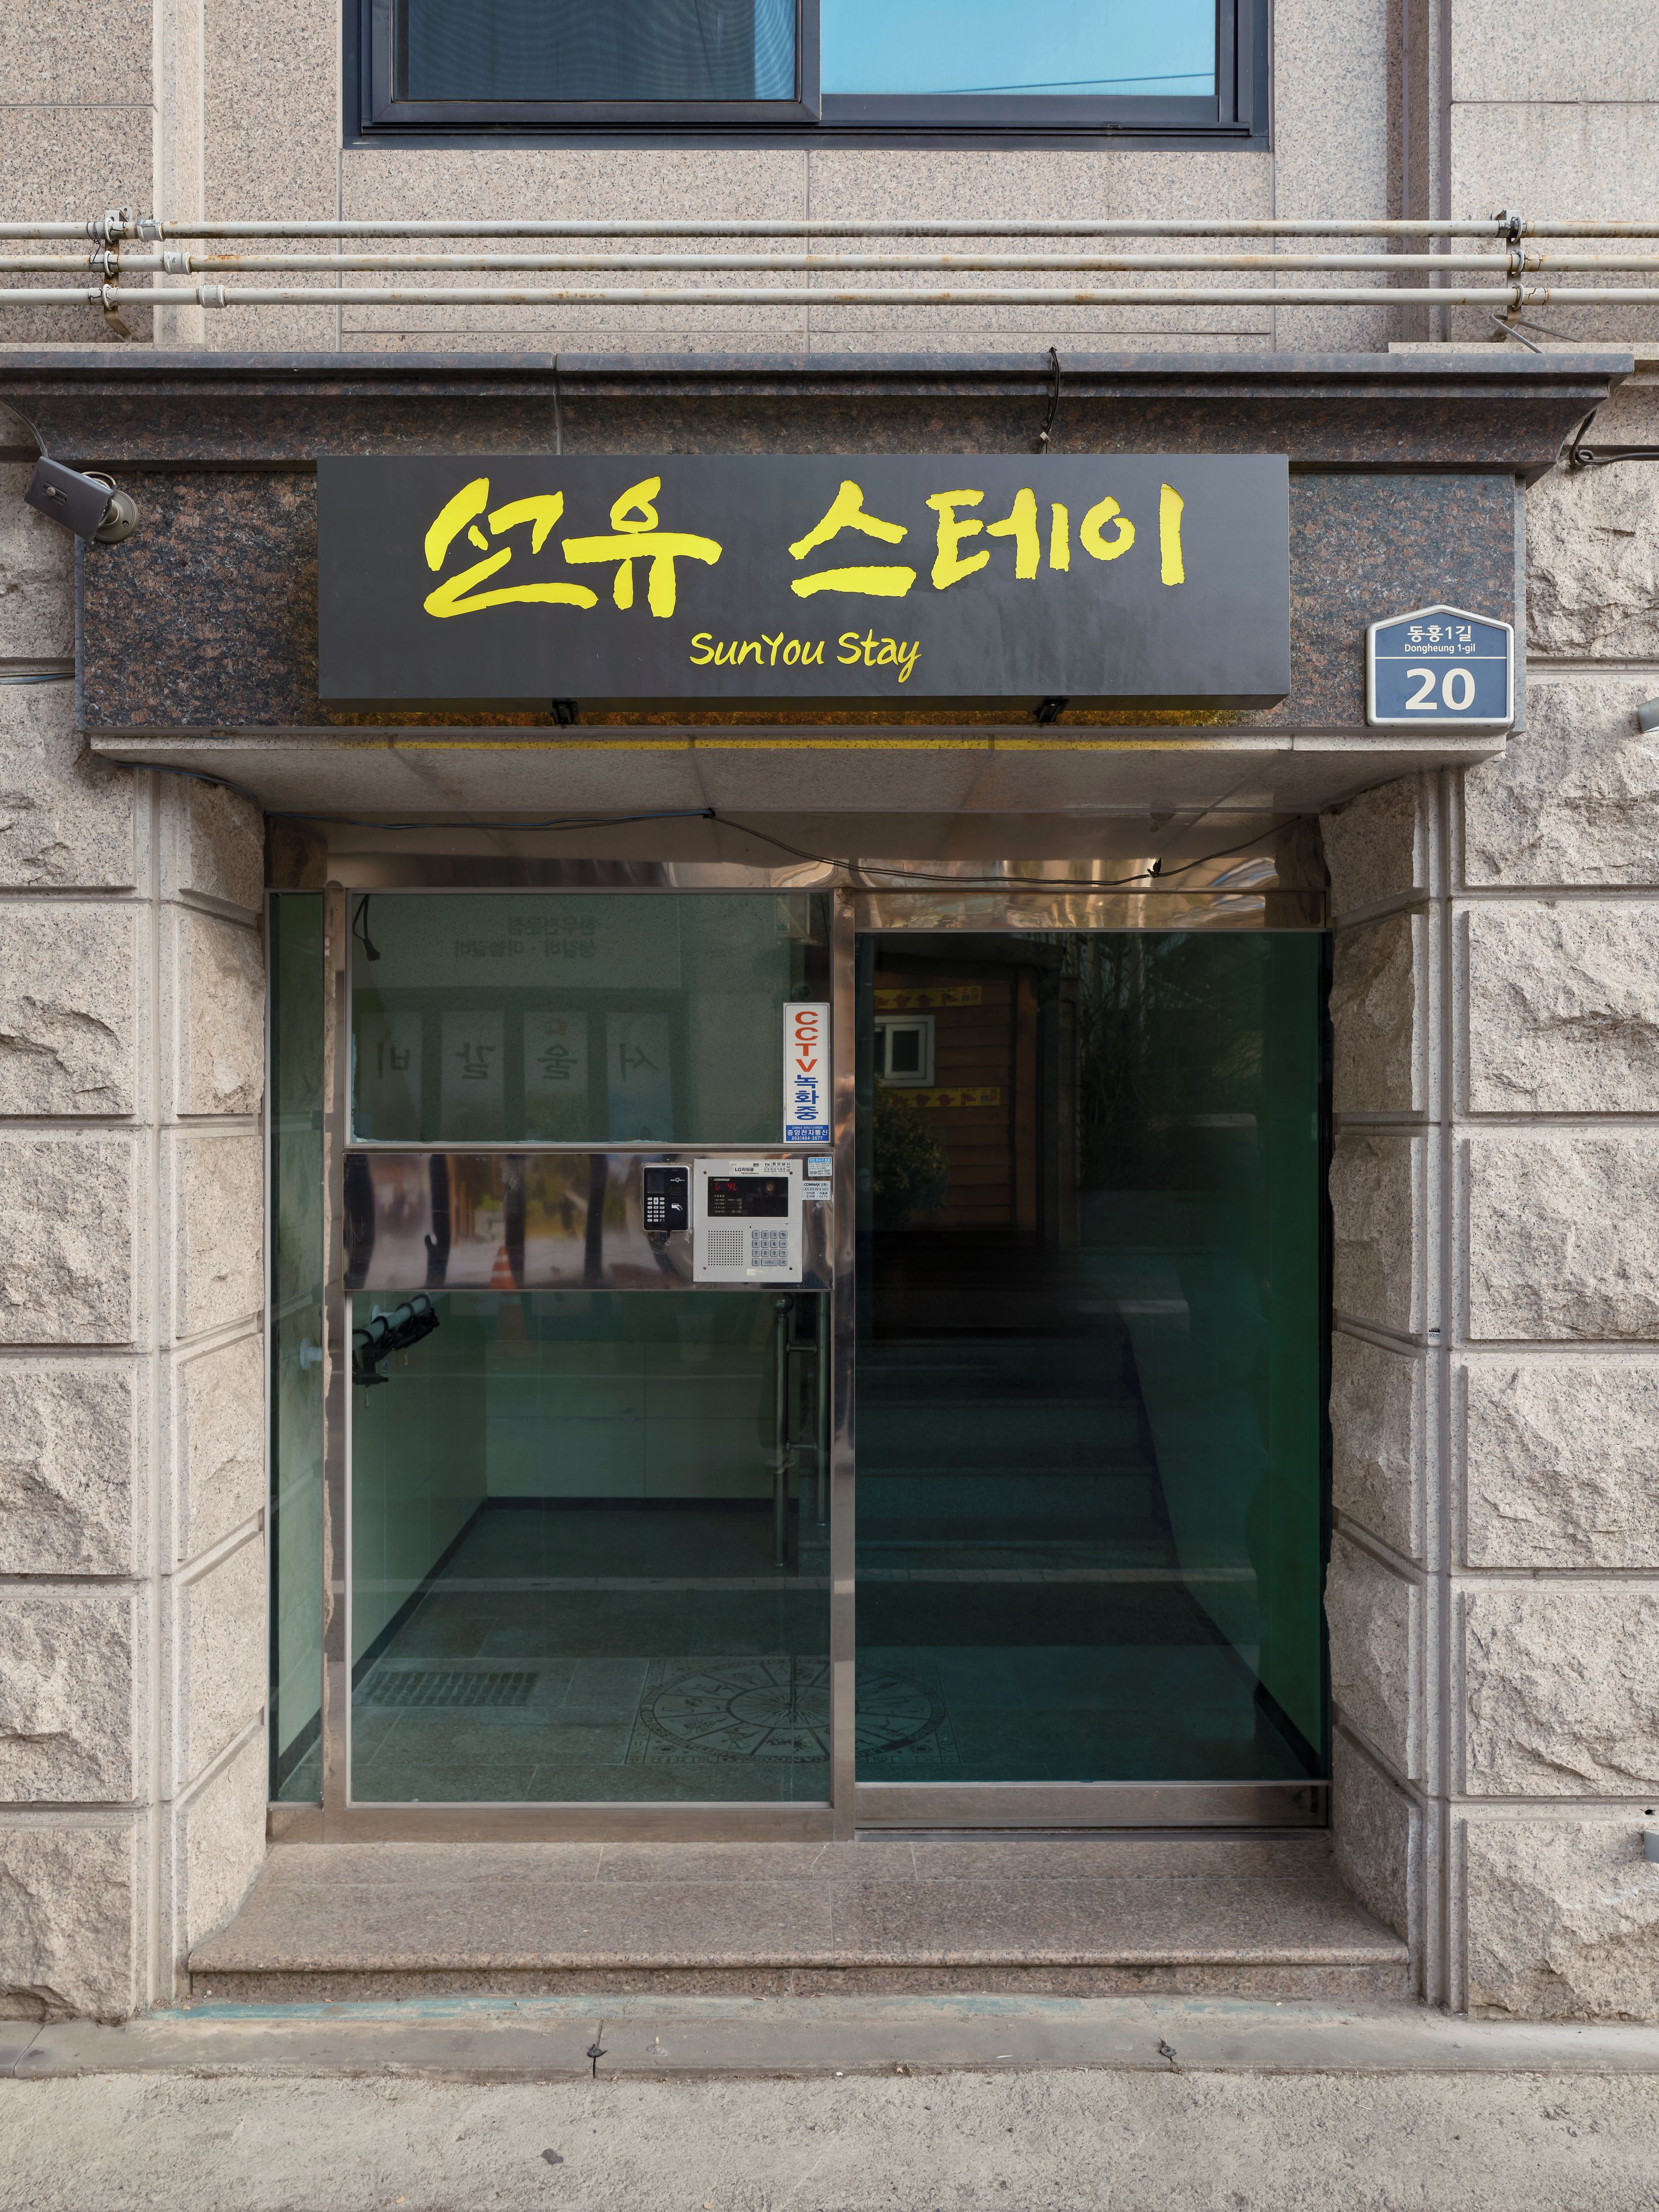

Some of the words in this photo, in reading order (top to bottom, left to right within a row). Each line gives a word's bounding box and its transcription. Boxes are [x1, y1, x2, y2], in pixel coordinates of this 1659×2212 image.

[424, 476, 722, 618] 선유
[789, 480, 1185, 599] 스테이
[1404, 643, 1455, 654] Dongheung
[1457, 643, 1476, 654] 1-gil
[1407, 625, 1472, 643] 동흥1길
[690, 631, 825, 666] SunYou
[836, 628, 922, 683] Stay
[1405, 668, 1475, 710] 20
